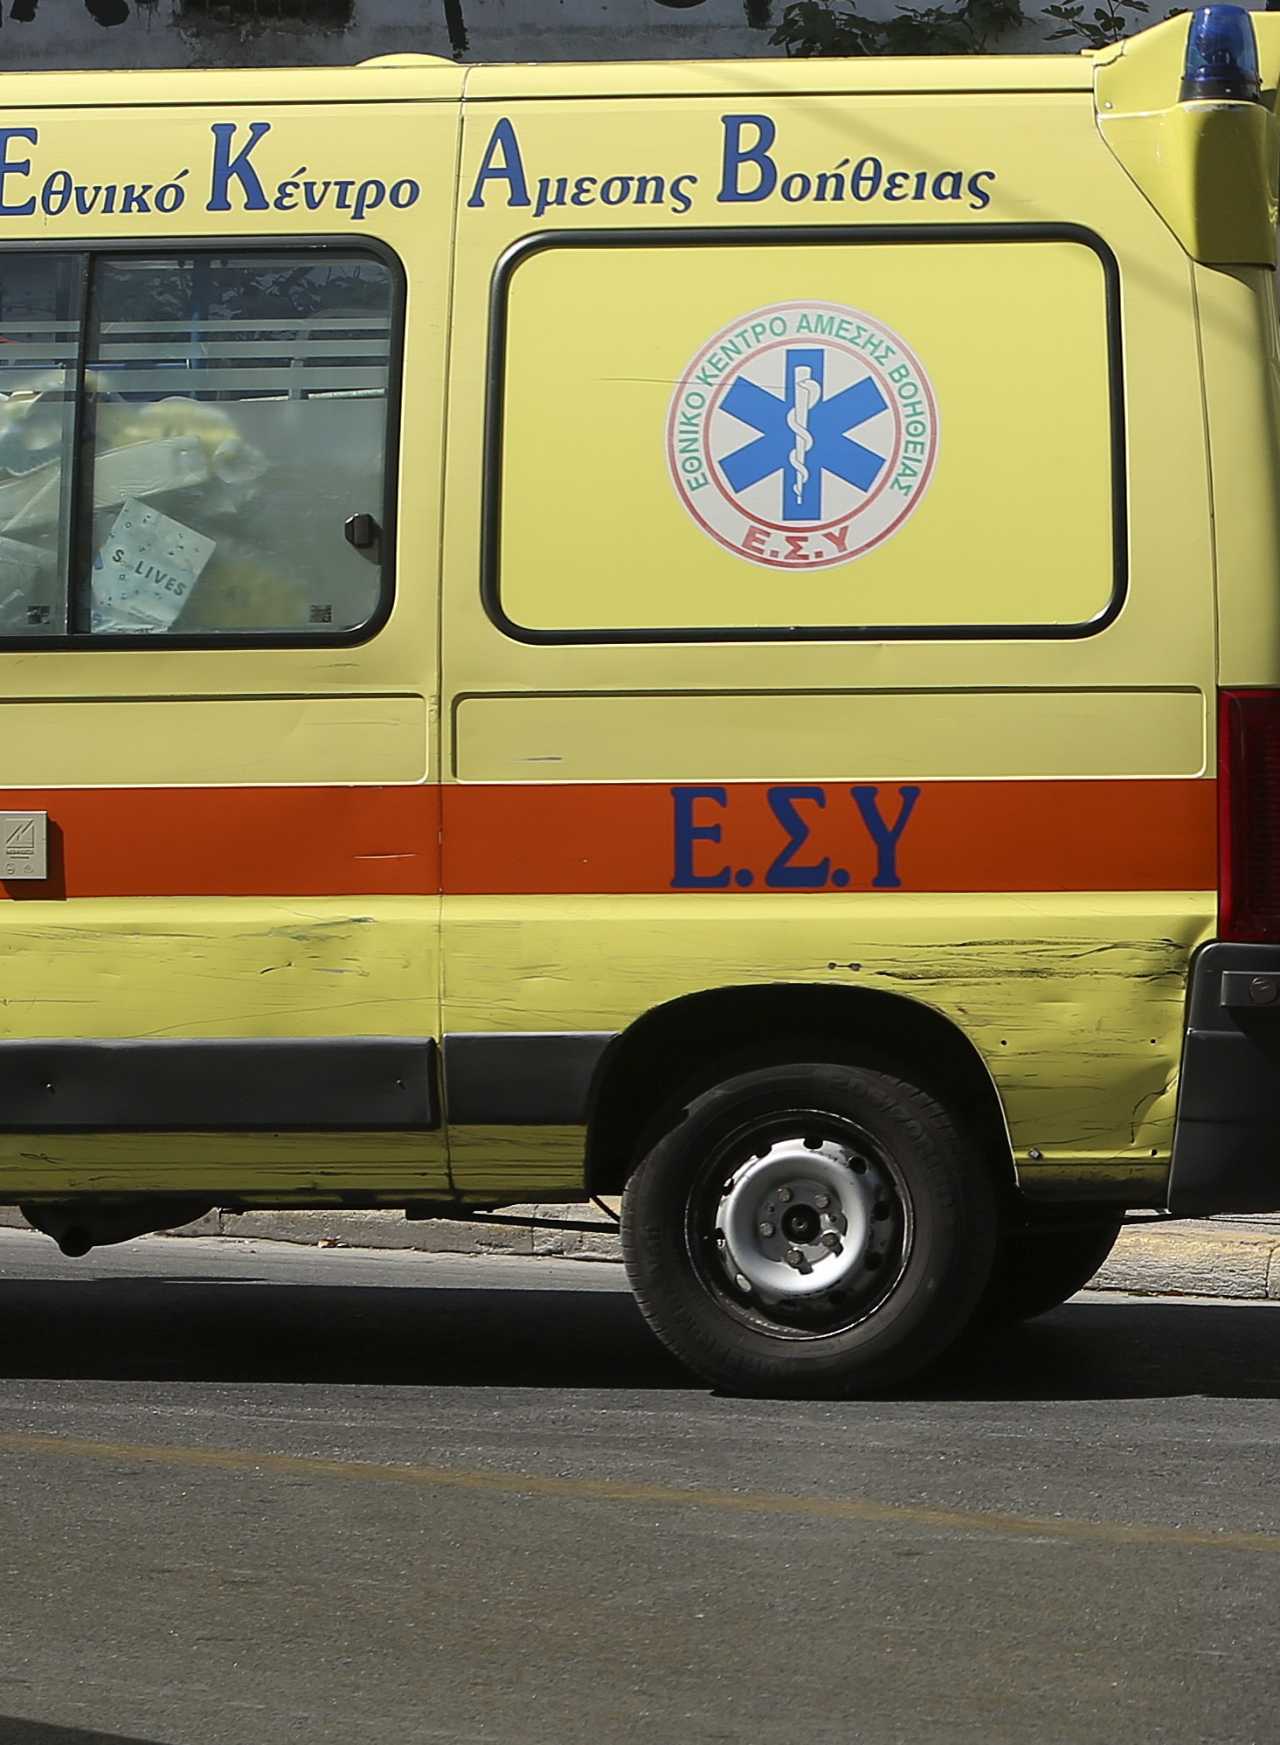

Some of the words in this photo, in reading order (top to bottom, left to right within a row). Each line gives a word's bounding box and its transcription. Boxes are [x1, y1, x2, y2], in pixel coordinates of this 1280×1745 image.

[0, 127, 190, 216] Εθνικό
[206, 121, 421, 220] Κέντρο
[466, 116, 698, 218] Αμεσης
[716, 113, 997, 210] Βοήθειας
[678, 391, 710, 492] ΕΘΝΙΚΟ
[695, 315, 788, 387] ΚΕΝΤΡΟ
[796, 313, 897, 367] ΑΜΕΣΗΣ
[887, 363, 927, 498] ΒΟΗΘΕΙΑΣ
[134, 560, 187, 597] LIVES
[670, 785, 921, 888] Ε.Σ.Υ
